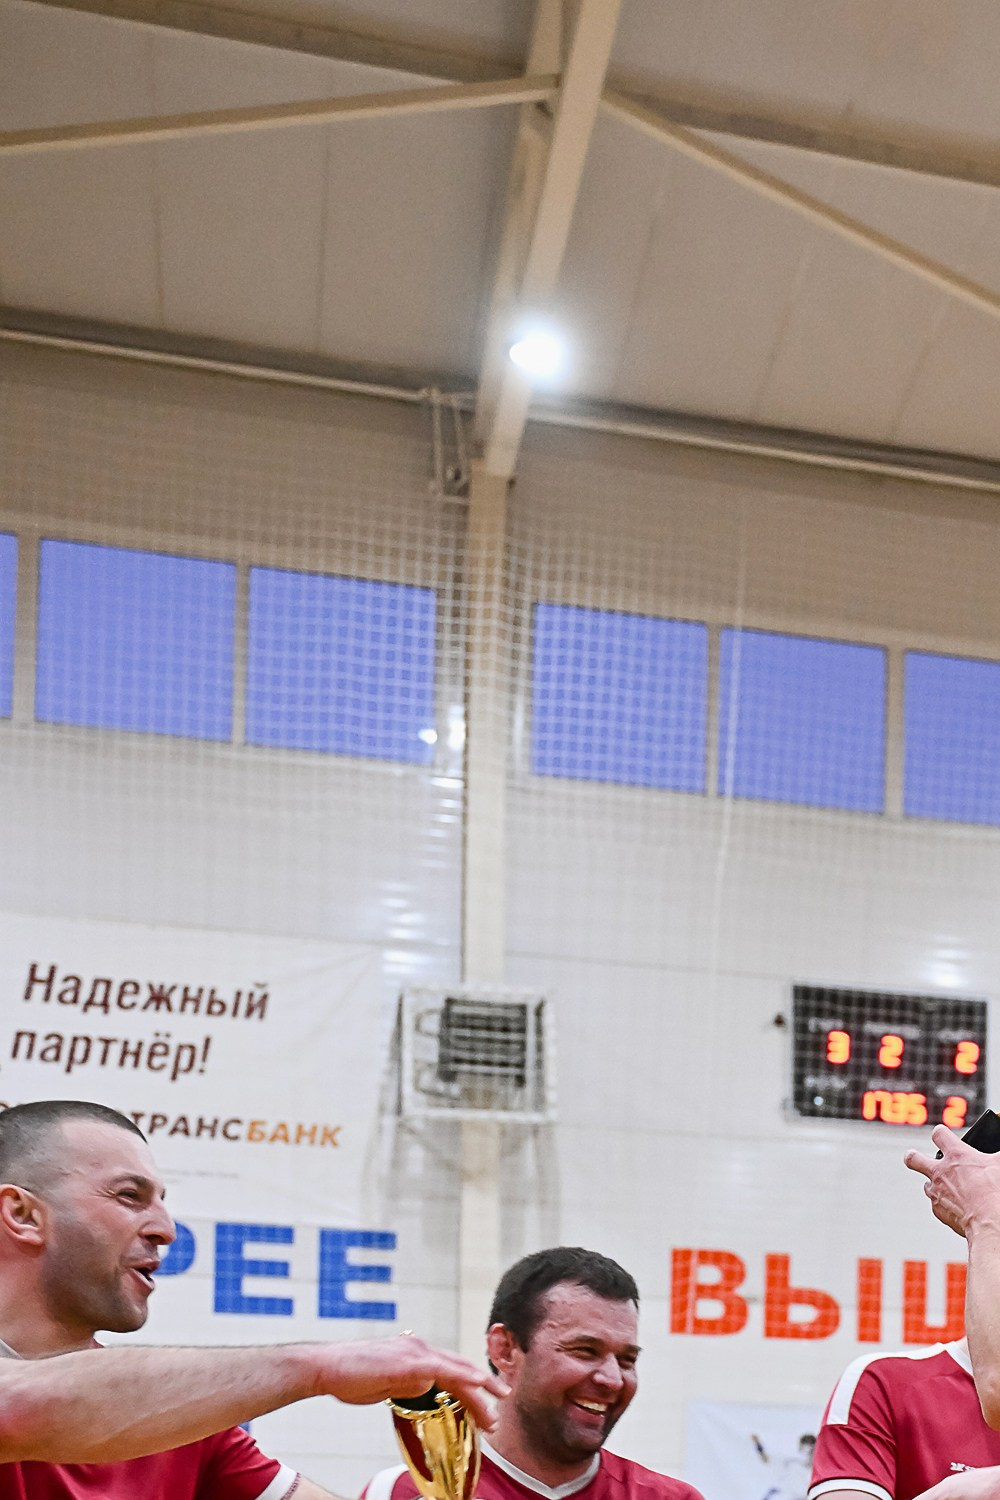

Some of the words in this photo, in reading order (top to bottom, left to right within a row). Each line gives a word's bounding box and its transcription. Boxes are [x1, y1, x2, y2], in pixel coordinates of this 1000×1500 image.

[22, 961, 270, 1022] Надежный
[10, 1030, 212, 1082] партнёр!
[827, 1031, 850, 1064] 3
[879, 1034, 904, 1068] 2
[955, 1040, 980, 1074] 2
[942, 1096, 967, 1128] 2
